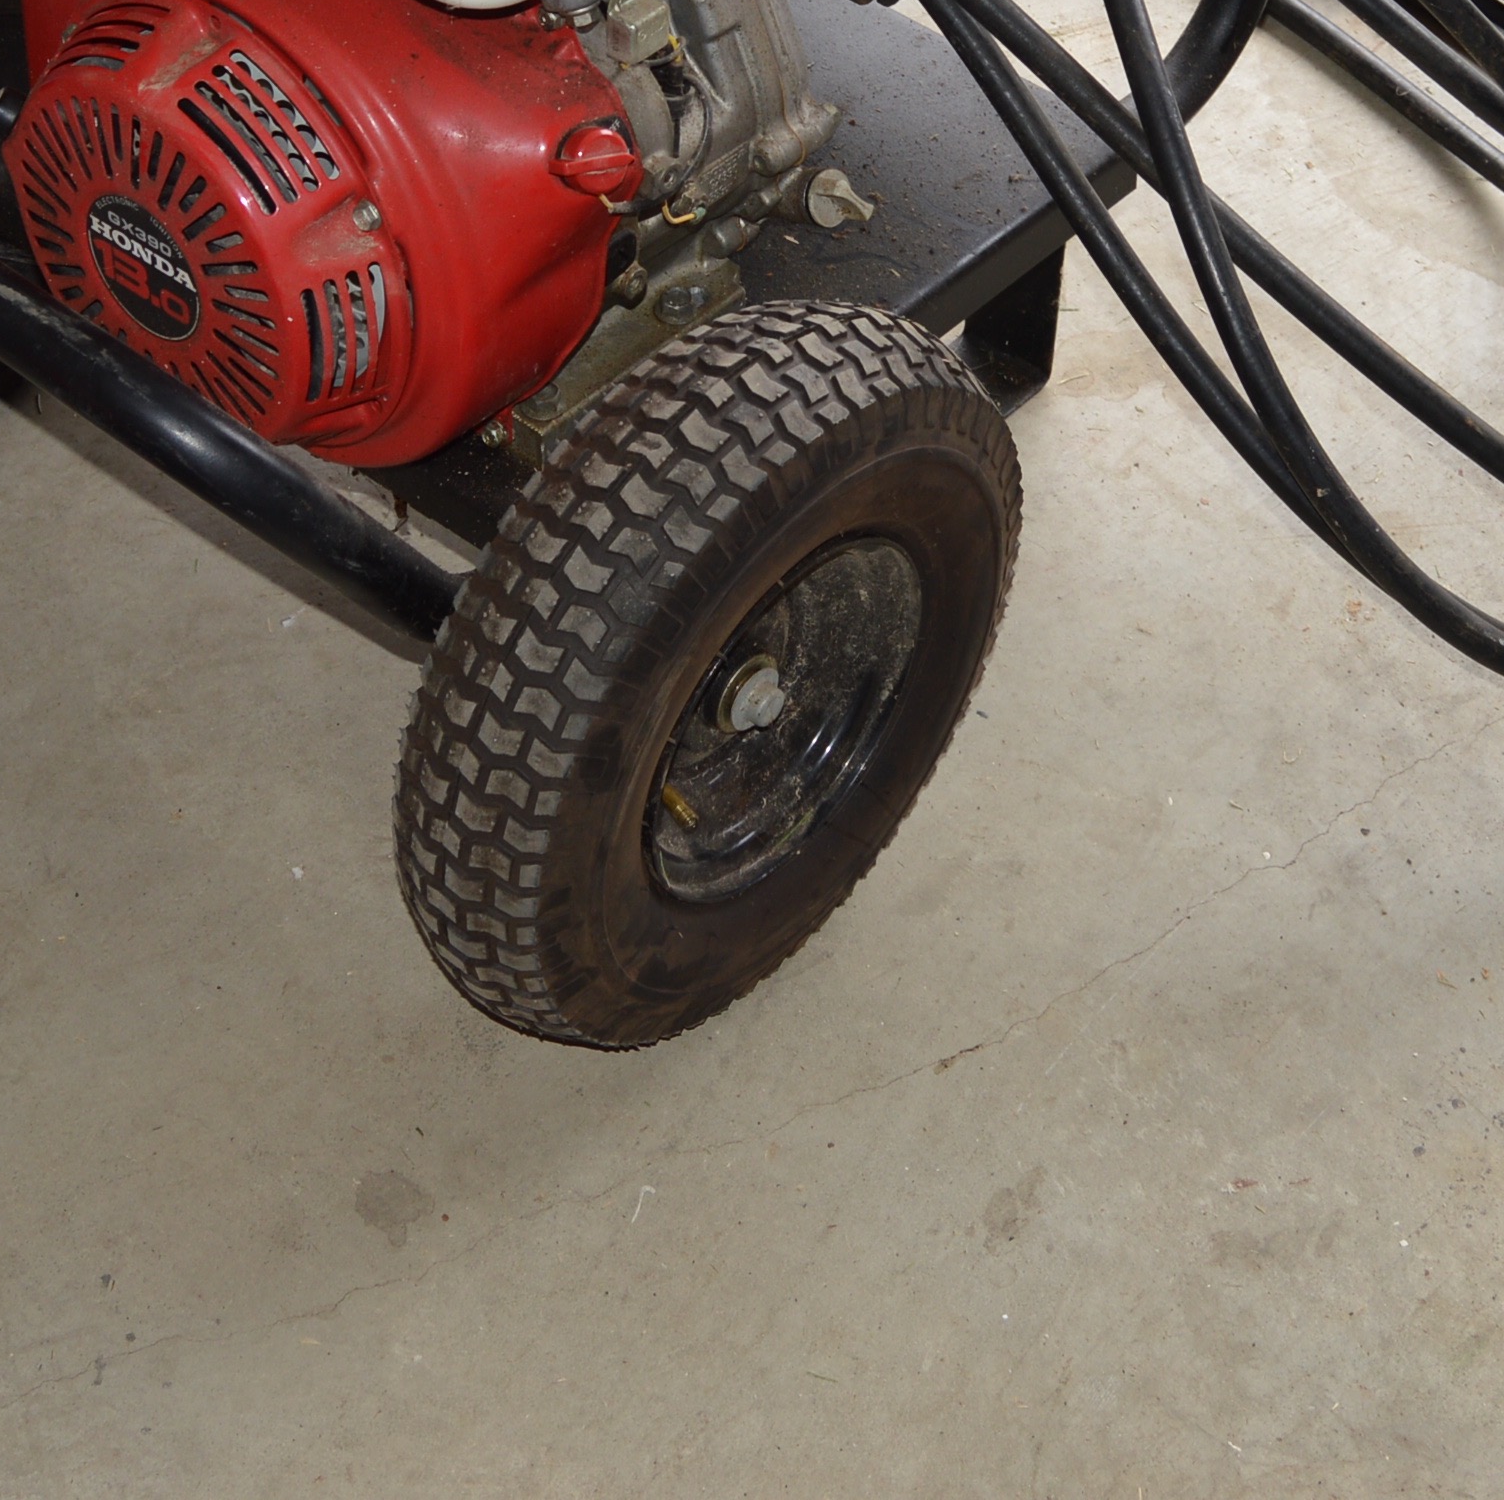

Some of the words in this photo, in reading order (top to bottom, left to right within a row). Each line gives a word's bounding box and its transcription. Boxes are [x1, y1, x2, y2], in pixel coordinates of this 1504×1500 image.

[89, 213, 197, 293] HONDA
[107, 210, 173, 258] GX390
[150, 216, 184, 260] IGNITION
[93, 238, 191, 326] 13.0
